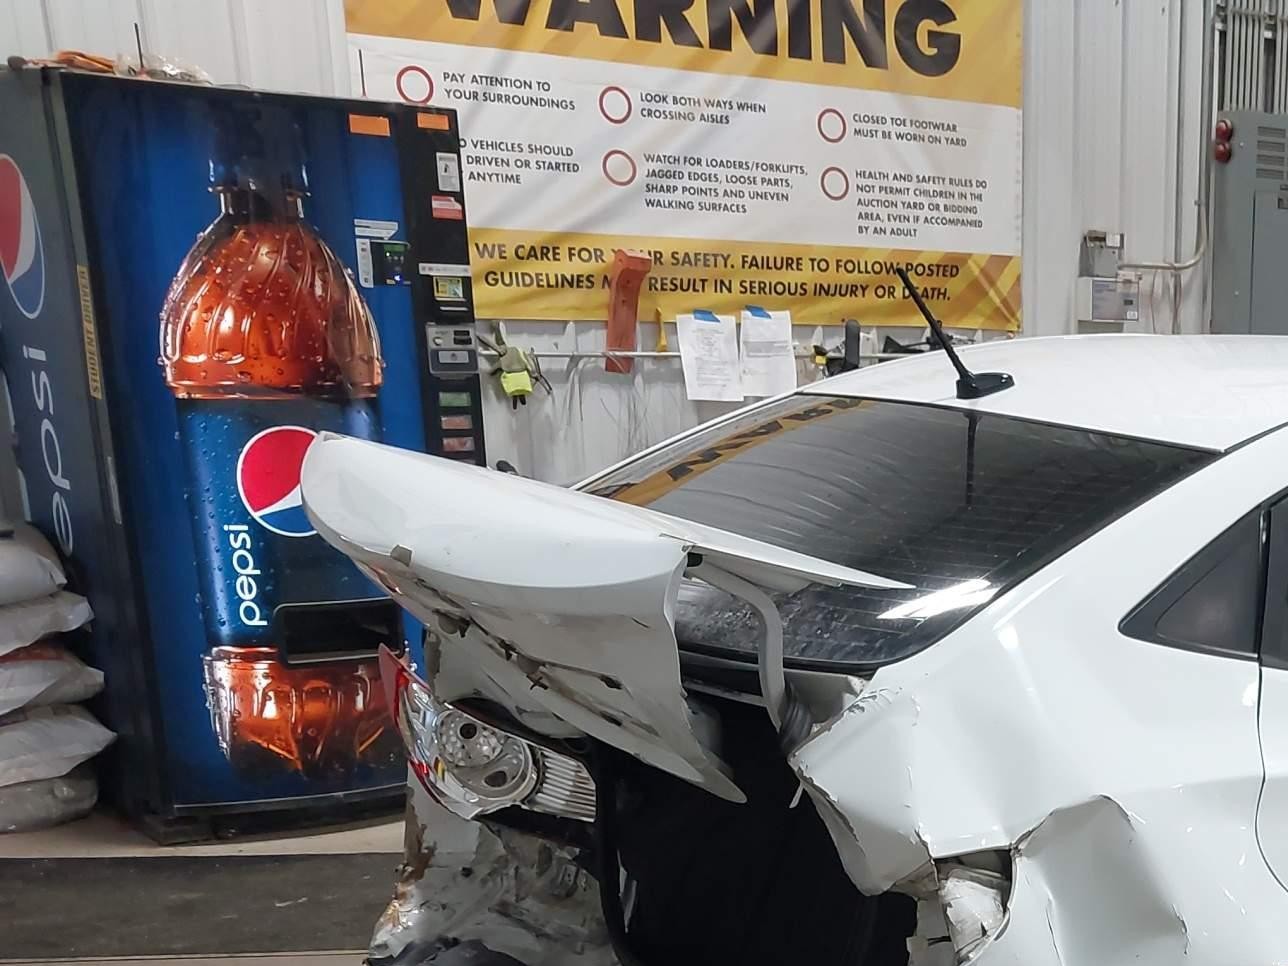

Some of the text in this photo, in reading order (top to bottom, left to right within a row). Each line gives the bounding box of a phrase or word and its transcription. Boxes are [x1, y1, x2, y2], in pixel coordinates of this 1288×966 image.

[443, 72, 550, 92] PAY ATTENTION TO
[444, 88, 575, 110] YOUR SURROUNDINGS
[640, 92, 766, 113] LOOK BOTH WAYS WHEN
[641, 108, 730, 124] CROSSING AISLES
[853, 114, 958, 132] CLOSED TOE FOOTWEAR
[854, 128, 966, 147] MUST BE WORN ON YARD
[471, 139, 524, 153] VEHICLES
[528, 144, 574, 156] SHOULD
[466, 155, 580, 173] DRIVEN OR STARTED
[644, 154, 808, 176] WATCH FOR LOADERS/FORKLIFTS,
[468, 172, 522, 184] ANYTIME
[646, 170, 793, 189] JAGGED EDGES, LOOSE PARTS,
[856, 170, 987, 189] HEALTH AND SAFETY RULES DO
[646, 184, 789, 202] SHARP POINTS AND UNEVEN
[856, 184, 982, 202] NOT PERMIT CHILDREN IN THE
[645, 199, 746, 214] WALKING SURFACES
[857, 198, 978, 214] AUCTION YARD OR BIDDING
[858, 212, 982, 228] AREA, EVEN IF ACCOMPANIED
[858, 226, 918, 238] BY AN ADULT
[475, 242, 507, 260] WE
[514, 245, 560, 262] CARE
[568, 247, 606, 263] FOR
[671, 251, 735, 269] SAFETY.
[741, 254, 803, 272] FAILURE
[808, 258, 830, 272] TO
[836, 259, 899, 276] FOLLOW
[906, 262, 960, 278] POSTED
[484, 270, 595, 289] GUIDELINES
[649, 276, 950, 301] RESULT IN SERIOUS INJURY OR DATH.
[79, 268, 99, 394] STUDENT DRIVER
[23, 345, 72, 557] epsi
[224, 524, 268, 626] pepsi
